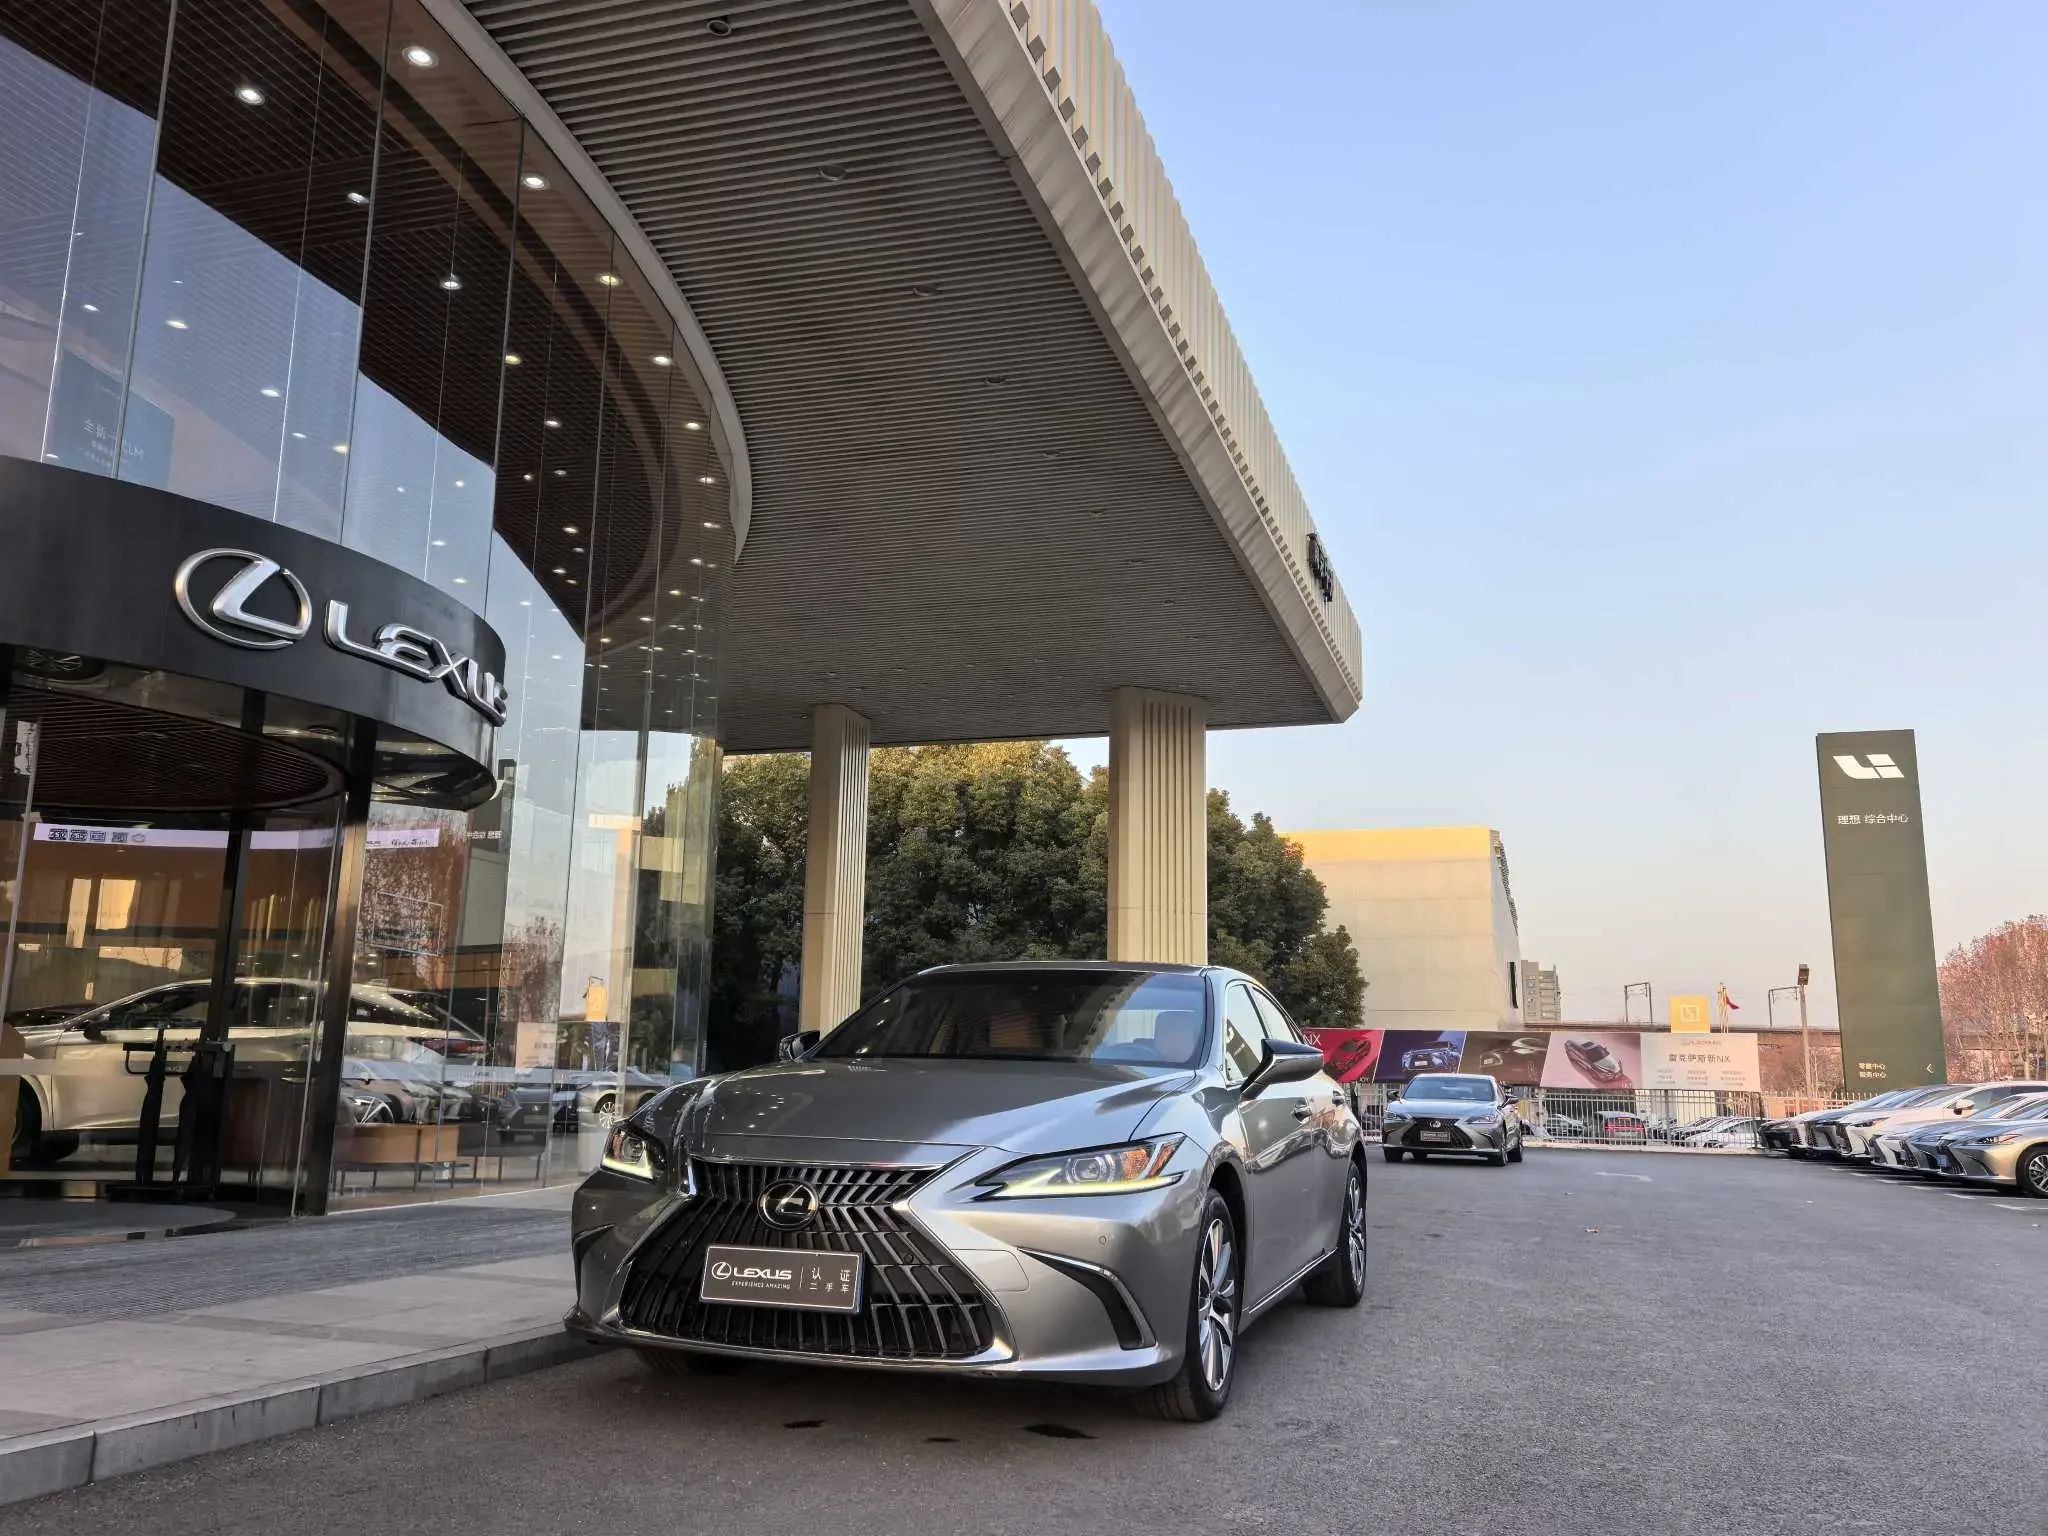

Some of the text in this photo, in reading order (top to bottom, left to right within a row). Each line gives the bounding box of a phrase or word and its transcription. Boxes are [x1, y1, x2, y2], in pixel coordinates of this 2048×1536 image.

[323, 599, 509, 728] LEXUS
[1837, 812, 1910, 825] 理想 综合中心
[733, 1267, 792, 1280] LEXUS
[765, 1282, 791, 1290] AMAZING
[809, 1282, 850, 1294] 二手车
